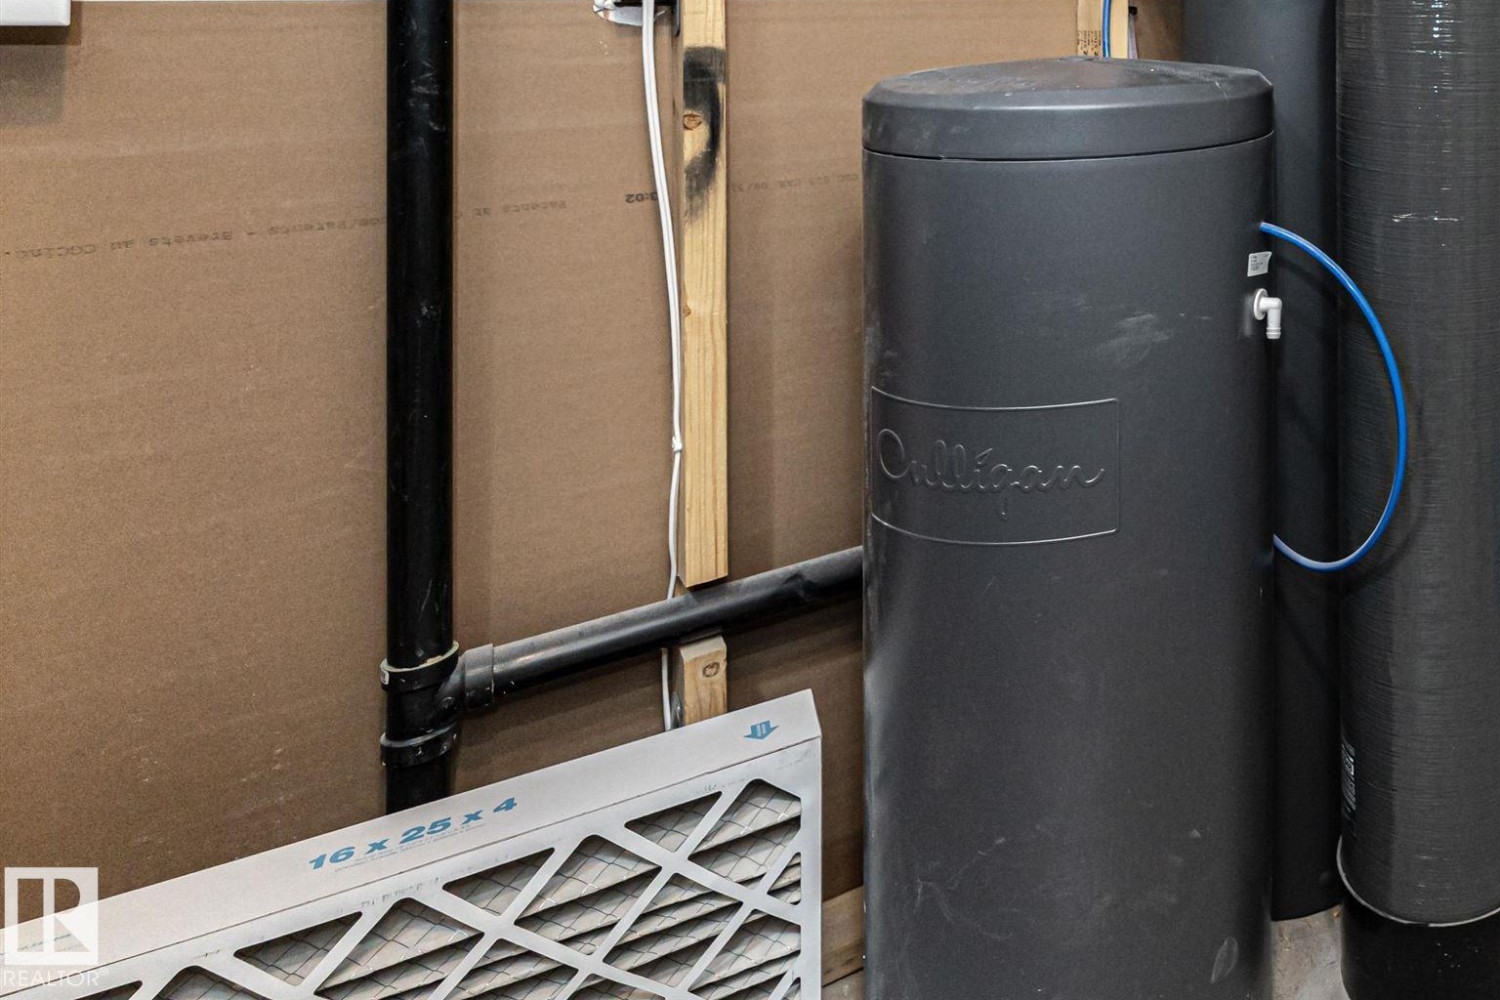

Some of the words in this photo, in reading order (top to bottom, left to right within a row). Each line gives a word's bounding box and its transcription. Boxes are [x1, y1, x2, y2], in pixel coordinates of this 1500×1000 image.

[877, 428, 1105, 519] Culligan
[308, 846, 356, 870] 16
[365, 838, 391, 855] x
[399, 817, 453, 845] 25
[462, 809, 484, 826] x
[493, 797, 519, 814] 4
